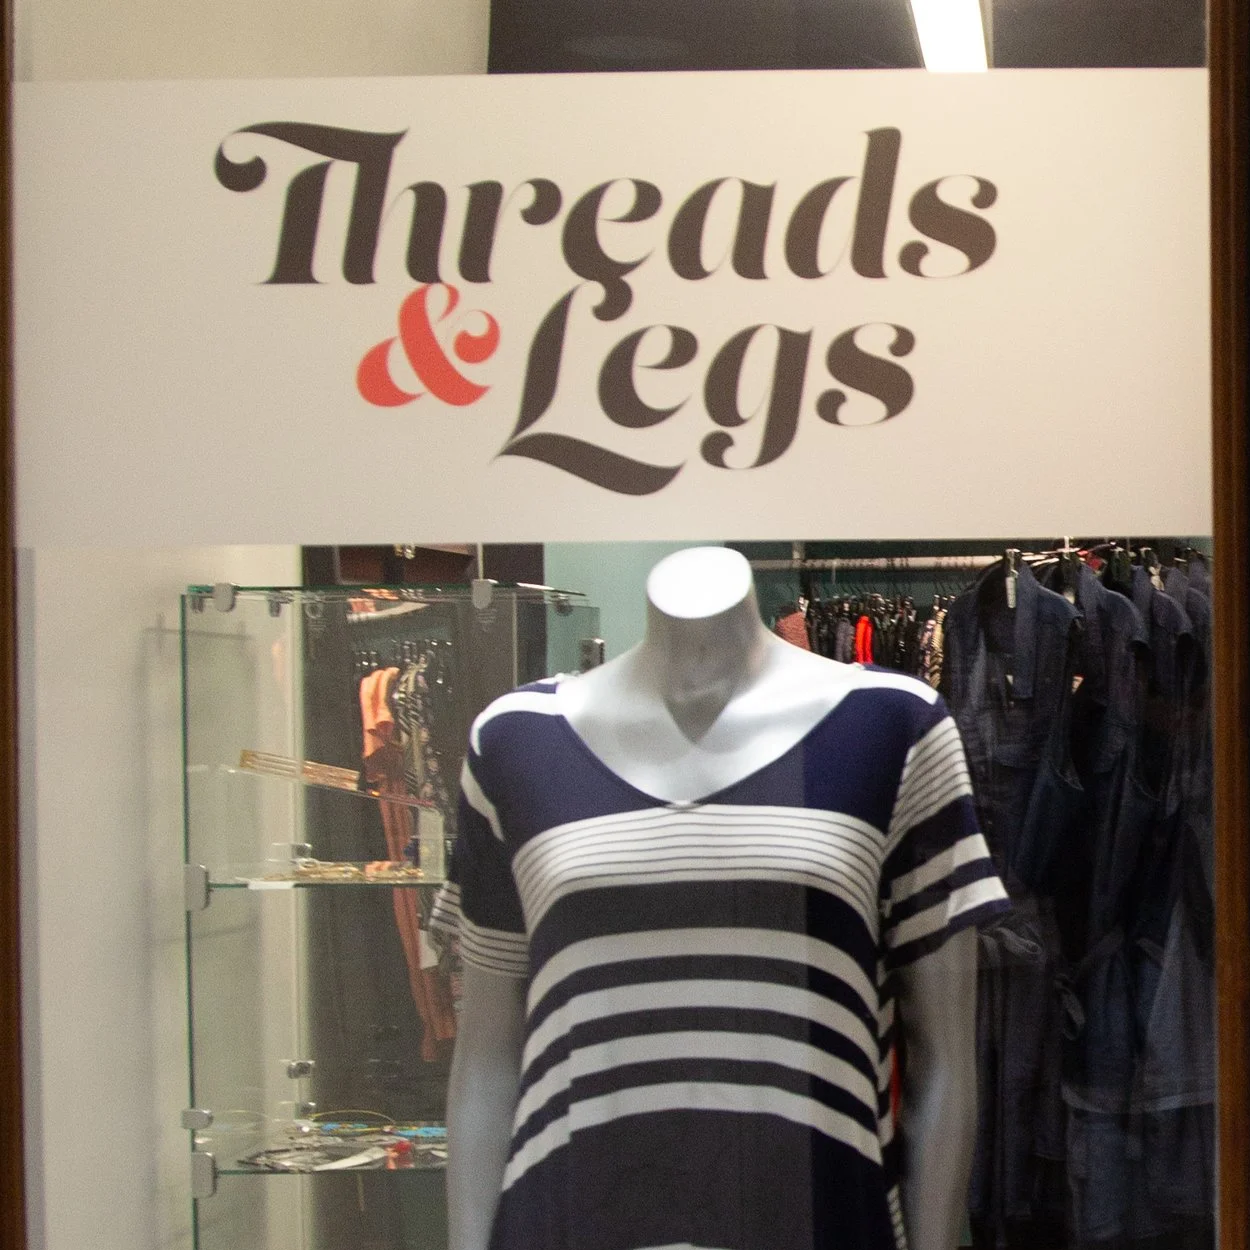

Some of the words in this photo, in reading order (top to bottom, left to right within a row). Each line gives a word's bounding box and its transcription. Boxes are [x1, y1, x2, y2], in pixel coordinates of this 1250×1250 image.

[214, 121, 999, 321] Threads
[355, 283, 500, 408] &
[489, 281, 916, 496] Legs
